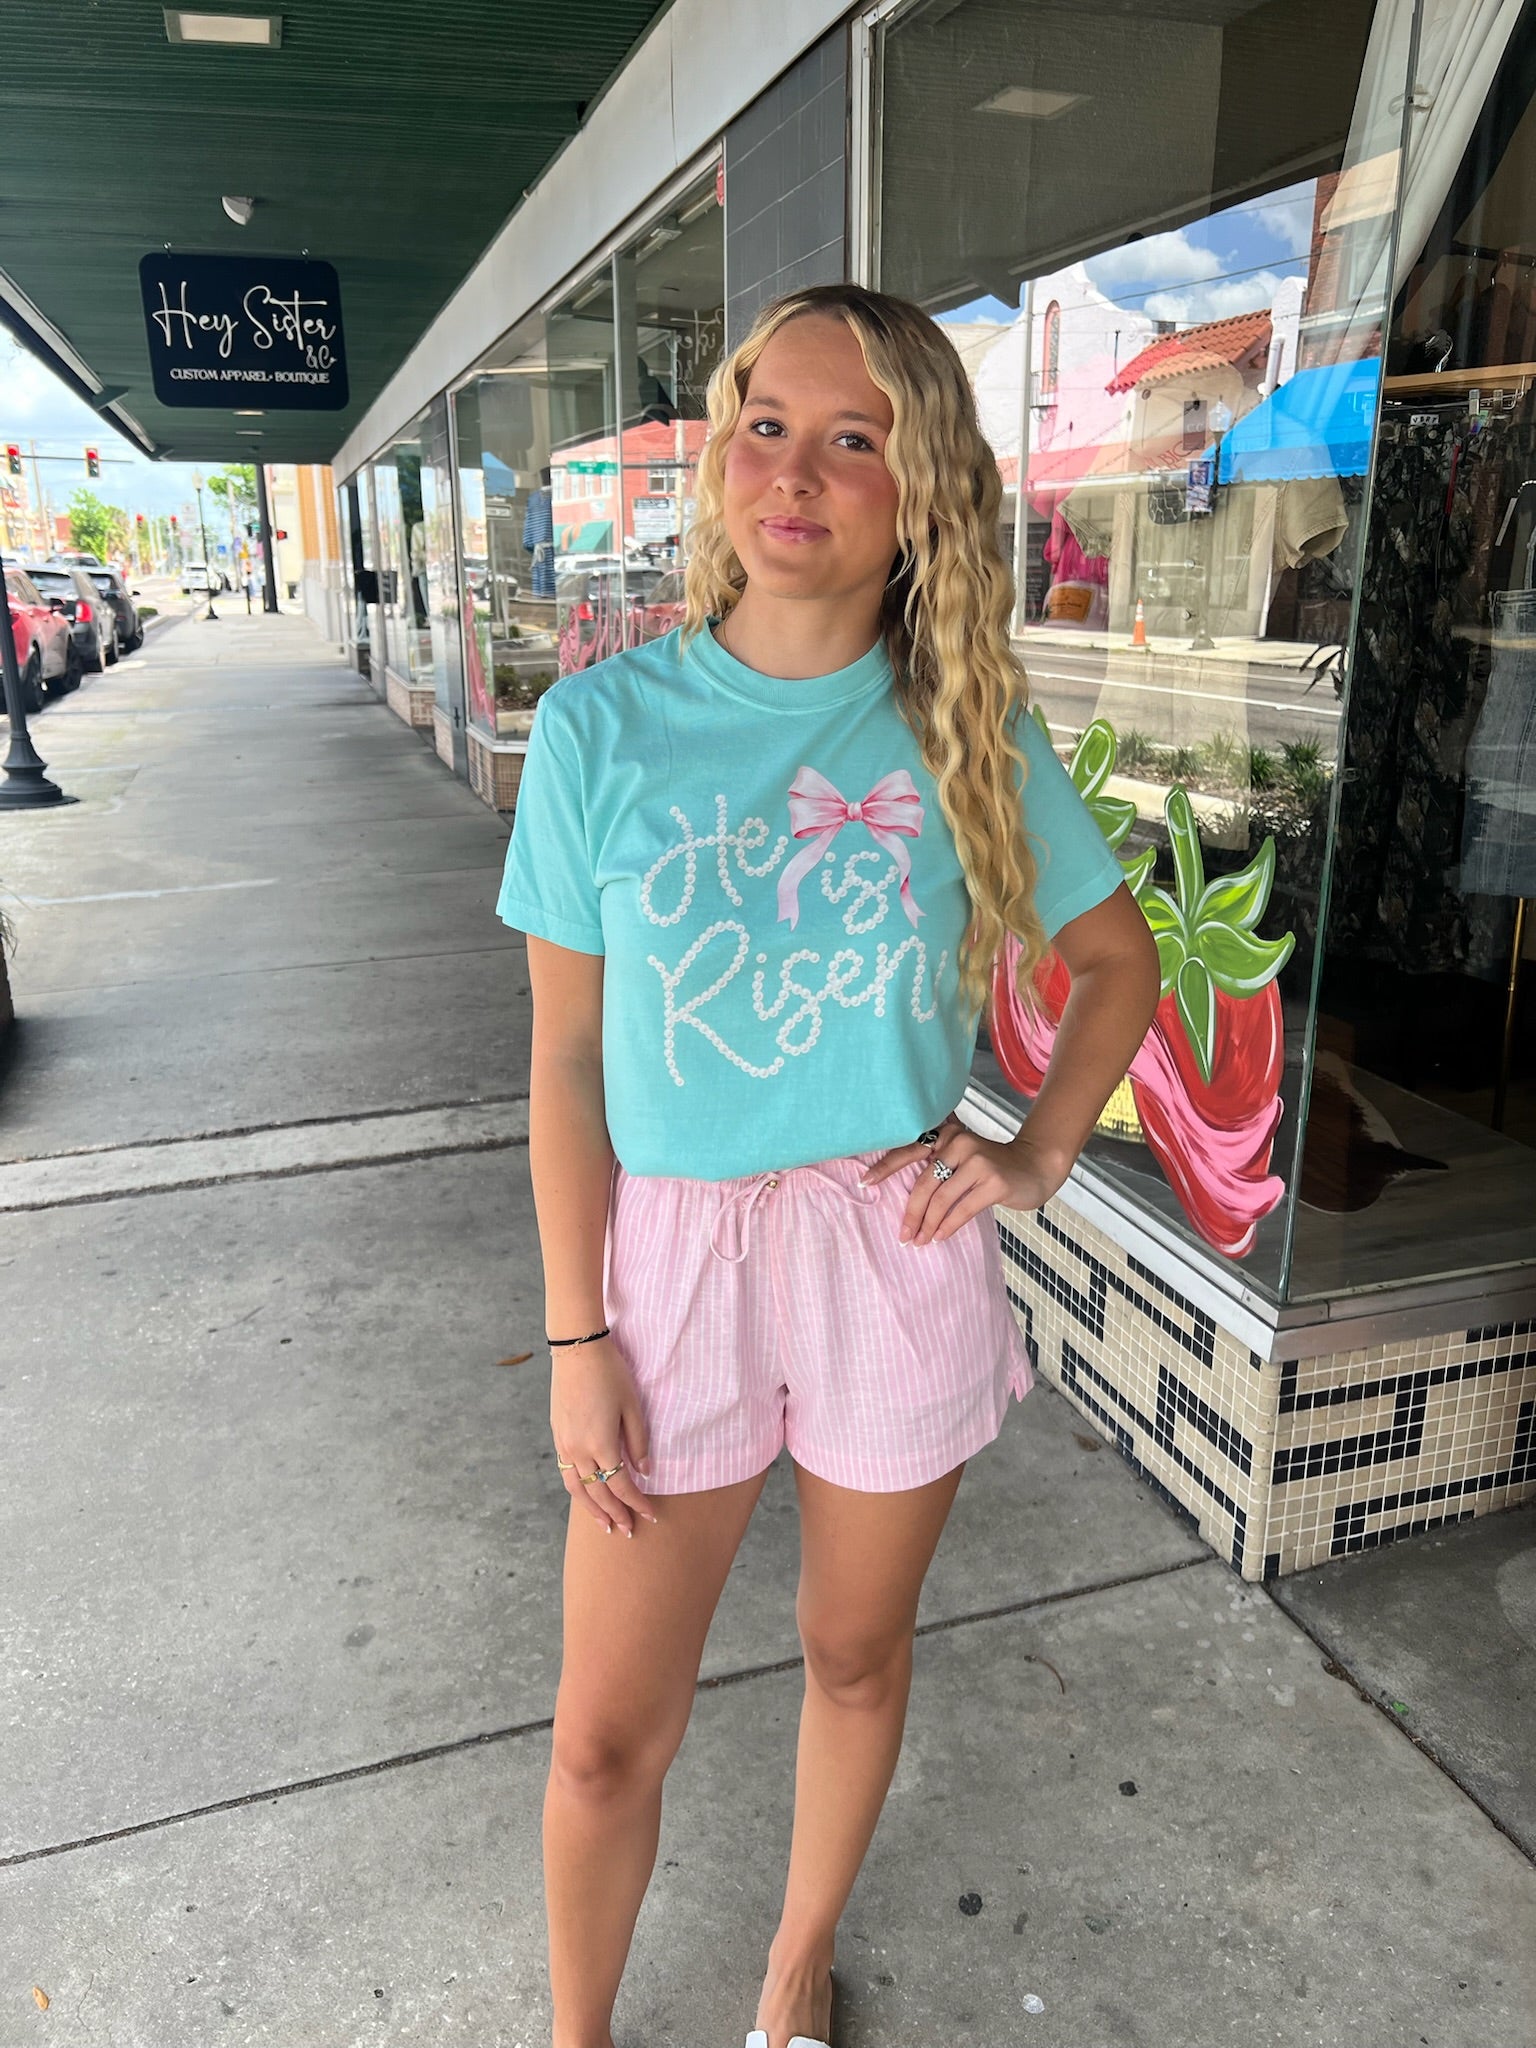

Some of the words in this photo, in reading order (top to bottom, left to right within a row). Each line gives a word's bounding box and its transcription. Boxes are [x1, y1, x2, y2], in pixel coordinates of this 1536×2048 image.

[152, 281, 239, 359] Hey
[243, 285, 337, 350] Sister
[170, 368, 218, 382] CUSTOM
[275, 372, 330, 385] BOUTIQUE
[640, 794, 789, 928] He
[821, 851, 900, 935] is
[647, 919, 950, 1087] Risen
